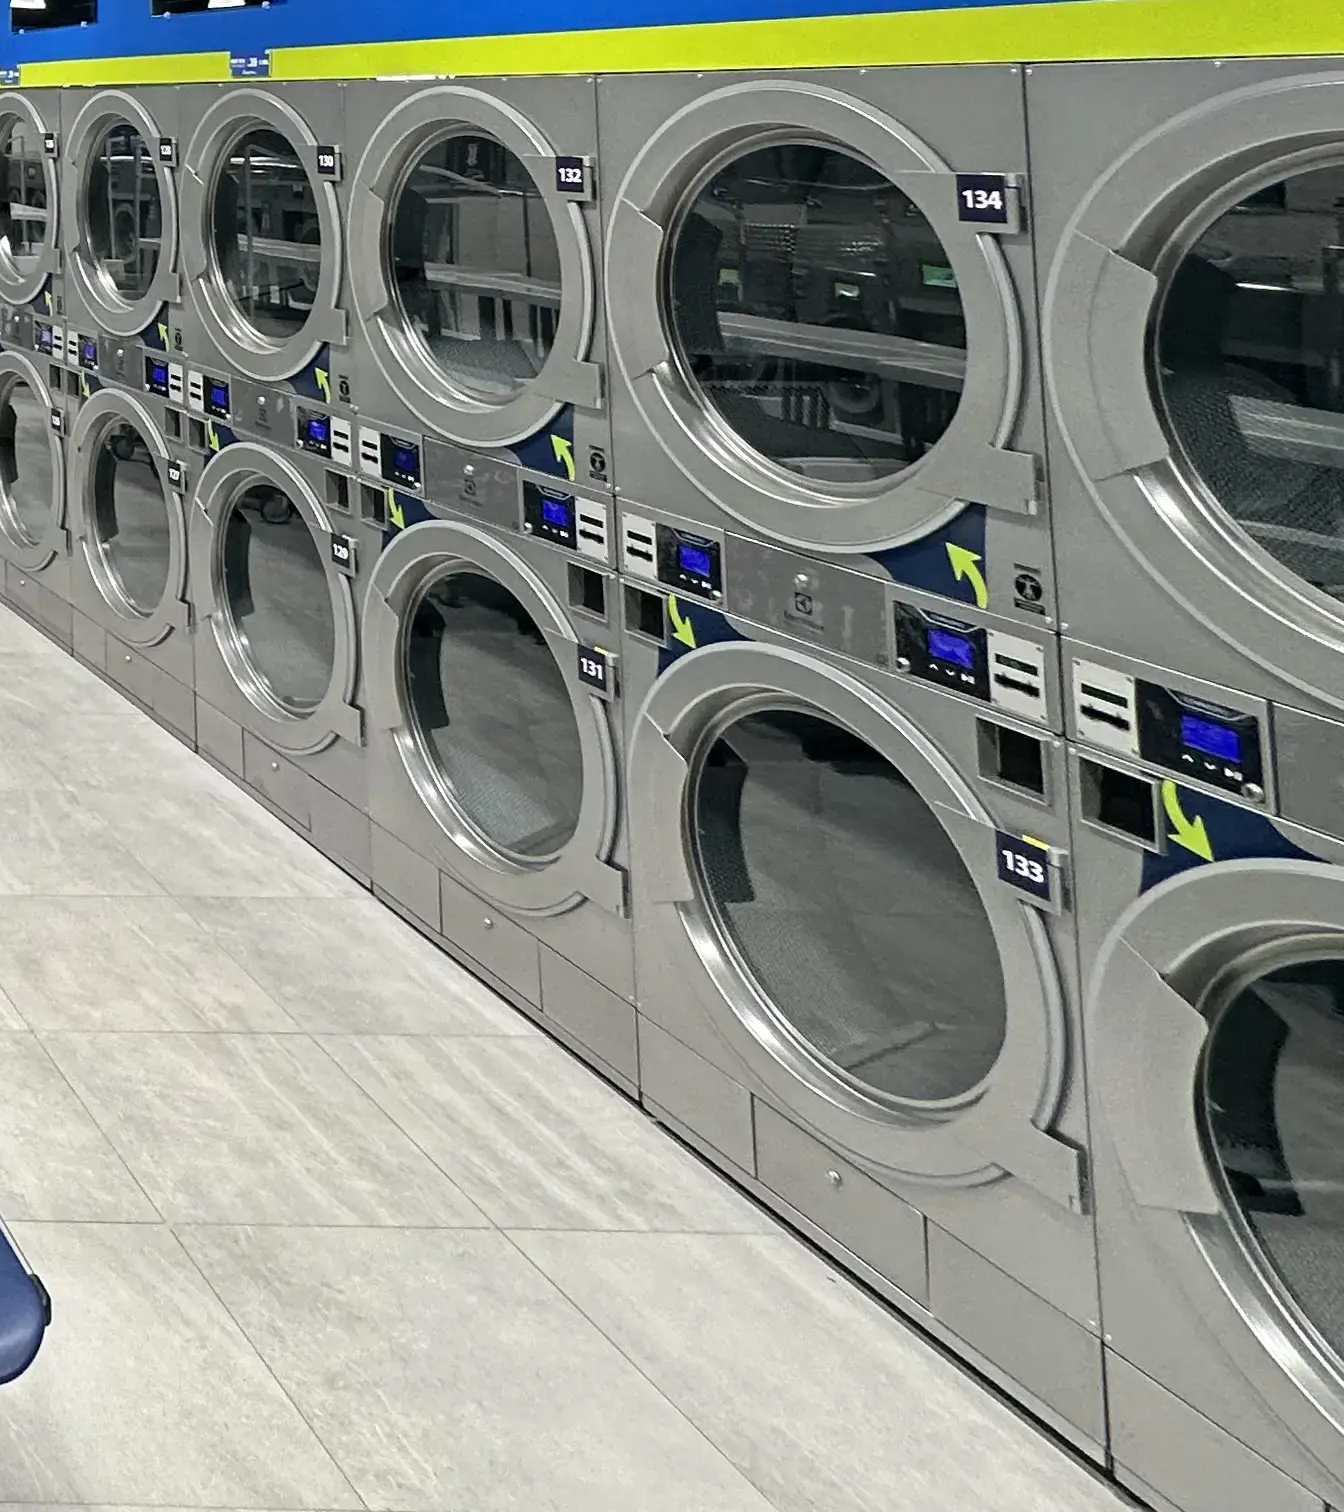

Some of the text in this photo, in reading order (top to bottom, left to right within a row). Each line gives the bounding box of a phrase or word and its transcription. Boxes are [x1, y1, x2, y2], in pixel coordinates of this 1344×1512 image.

[318, 155, 333, 167] 130
[558, 167, 582, 183] 132
[962, 189, 1003, 210] 134
[580, 657, 603, 680] 131
[1002, 849, 1045, 883] 133
